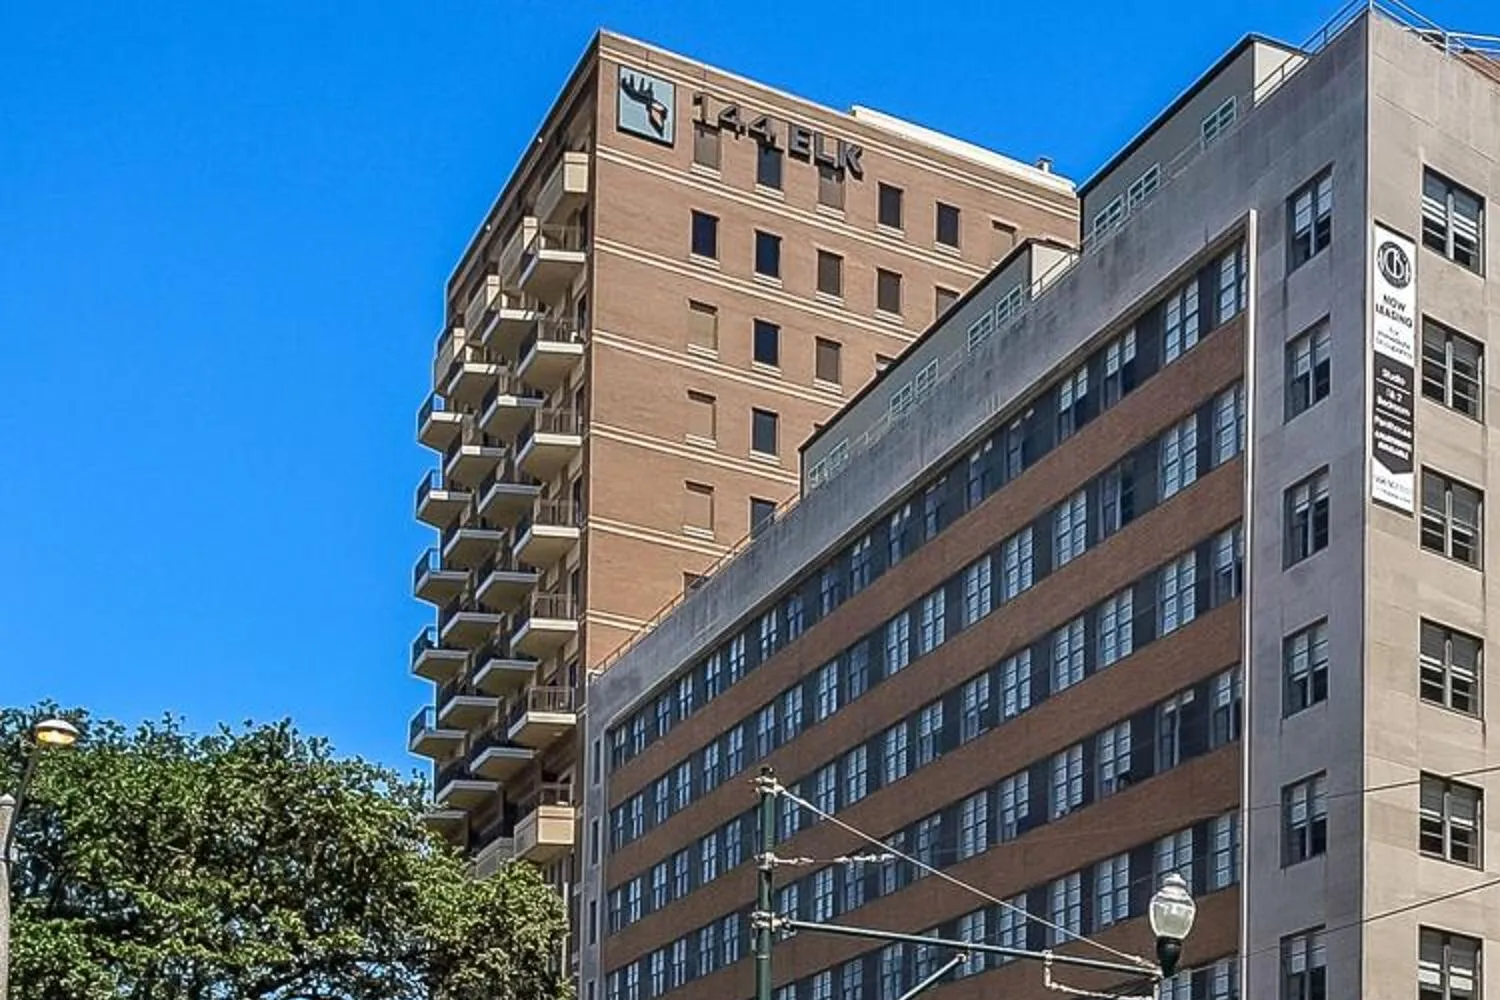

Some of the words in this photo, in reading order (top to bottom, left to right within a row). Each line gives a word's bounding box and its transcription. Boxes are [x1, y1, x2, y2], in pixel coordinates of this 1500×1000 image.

[691, 93, 779, 144] 144
[786, 122, 865, 178] ELK
[1383, 294, 1406, 312] NOW
